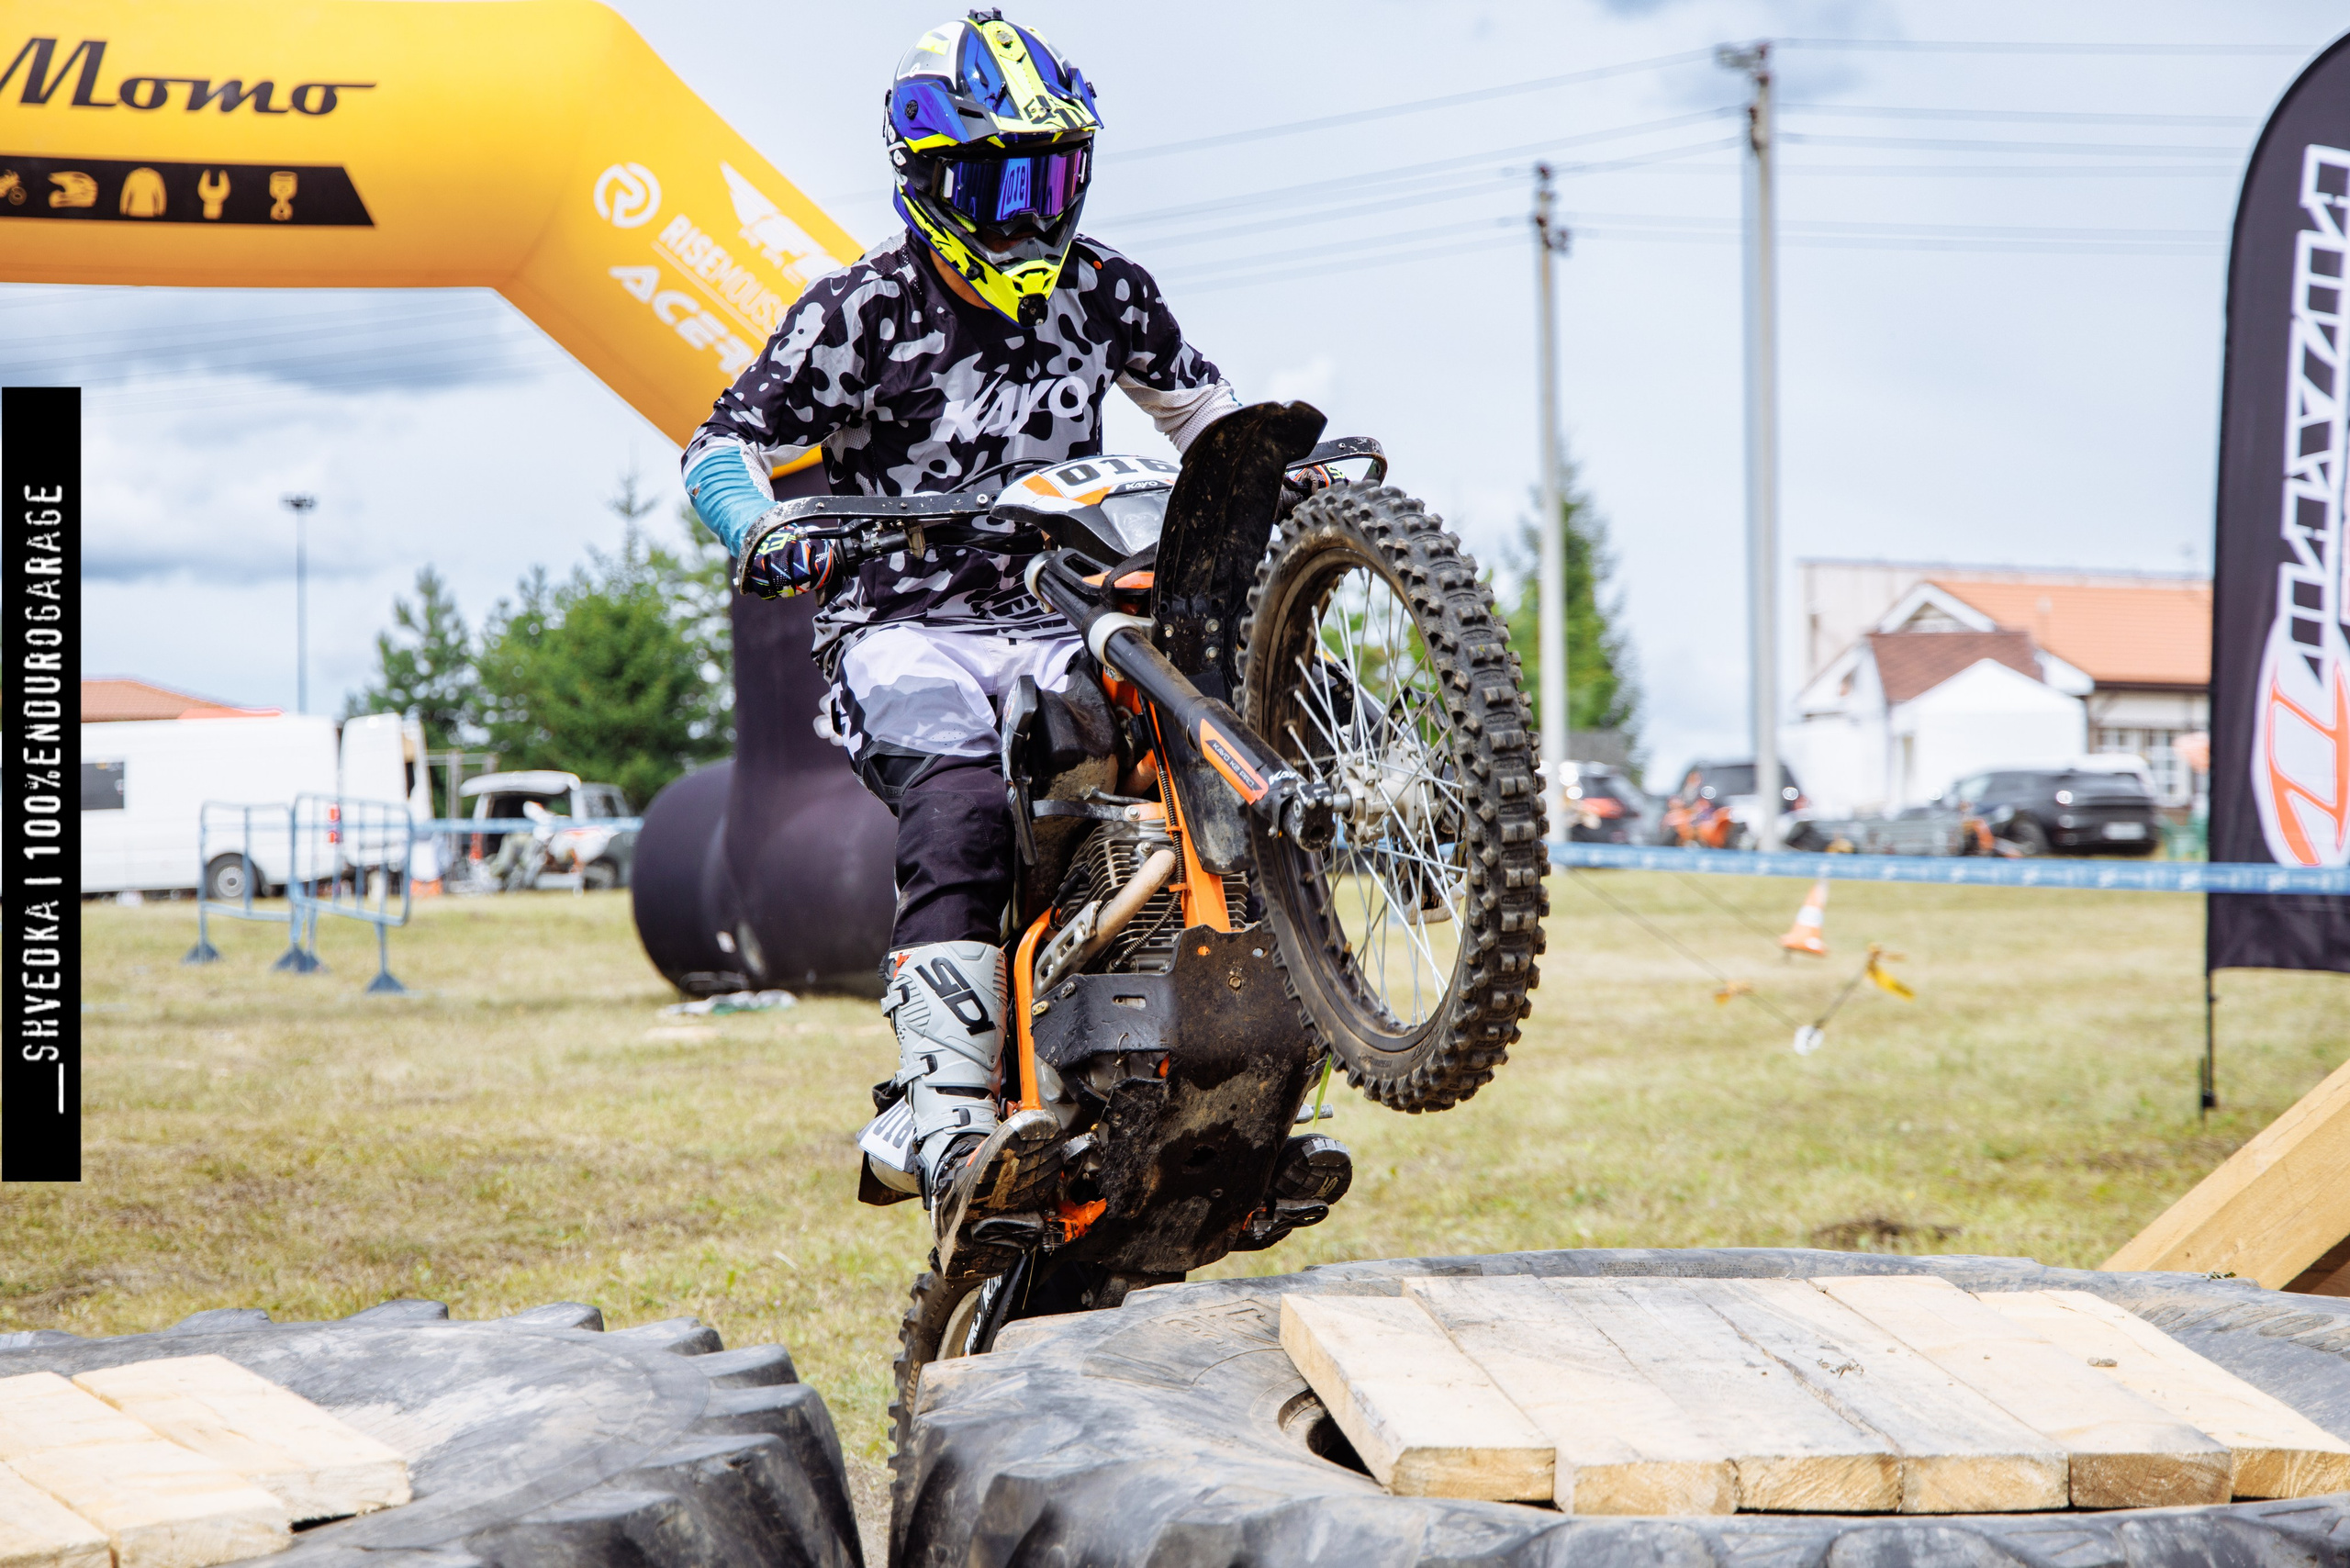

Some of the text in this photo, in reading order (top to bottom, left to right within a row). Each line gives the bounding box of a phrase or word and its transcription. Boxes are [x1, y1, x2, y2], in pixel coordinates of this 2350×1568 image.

[657, 213, 789, 334] RISEMOUSS
[608, 264, 758, 380] ACER
[932, 372, 1090, 444] KAYO
[1056, 458, 1180, 487] 016
[1125, 479, 1158, 490] KAYO
[914, 957, 997, 1036] SIDI
